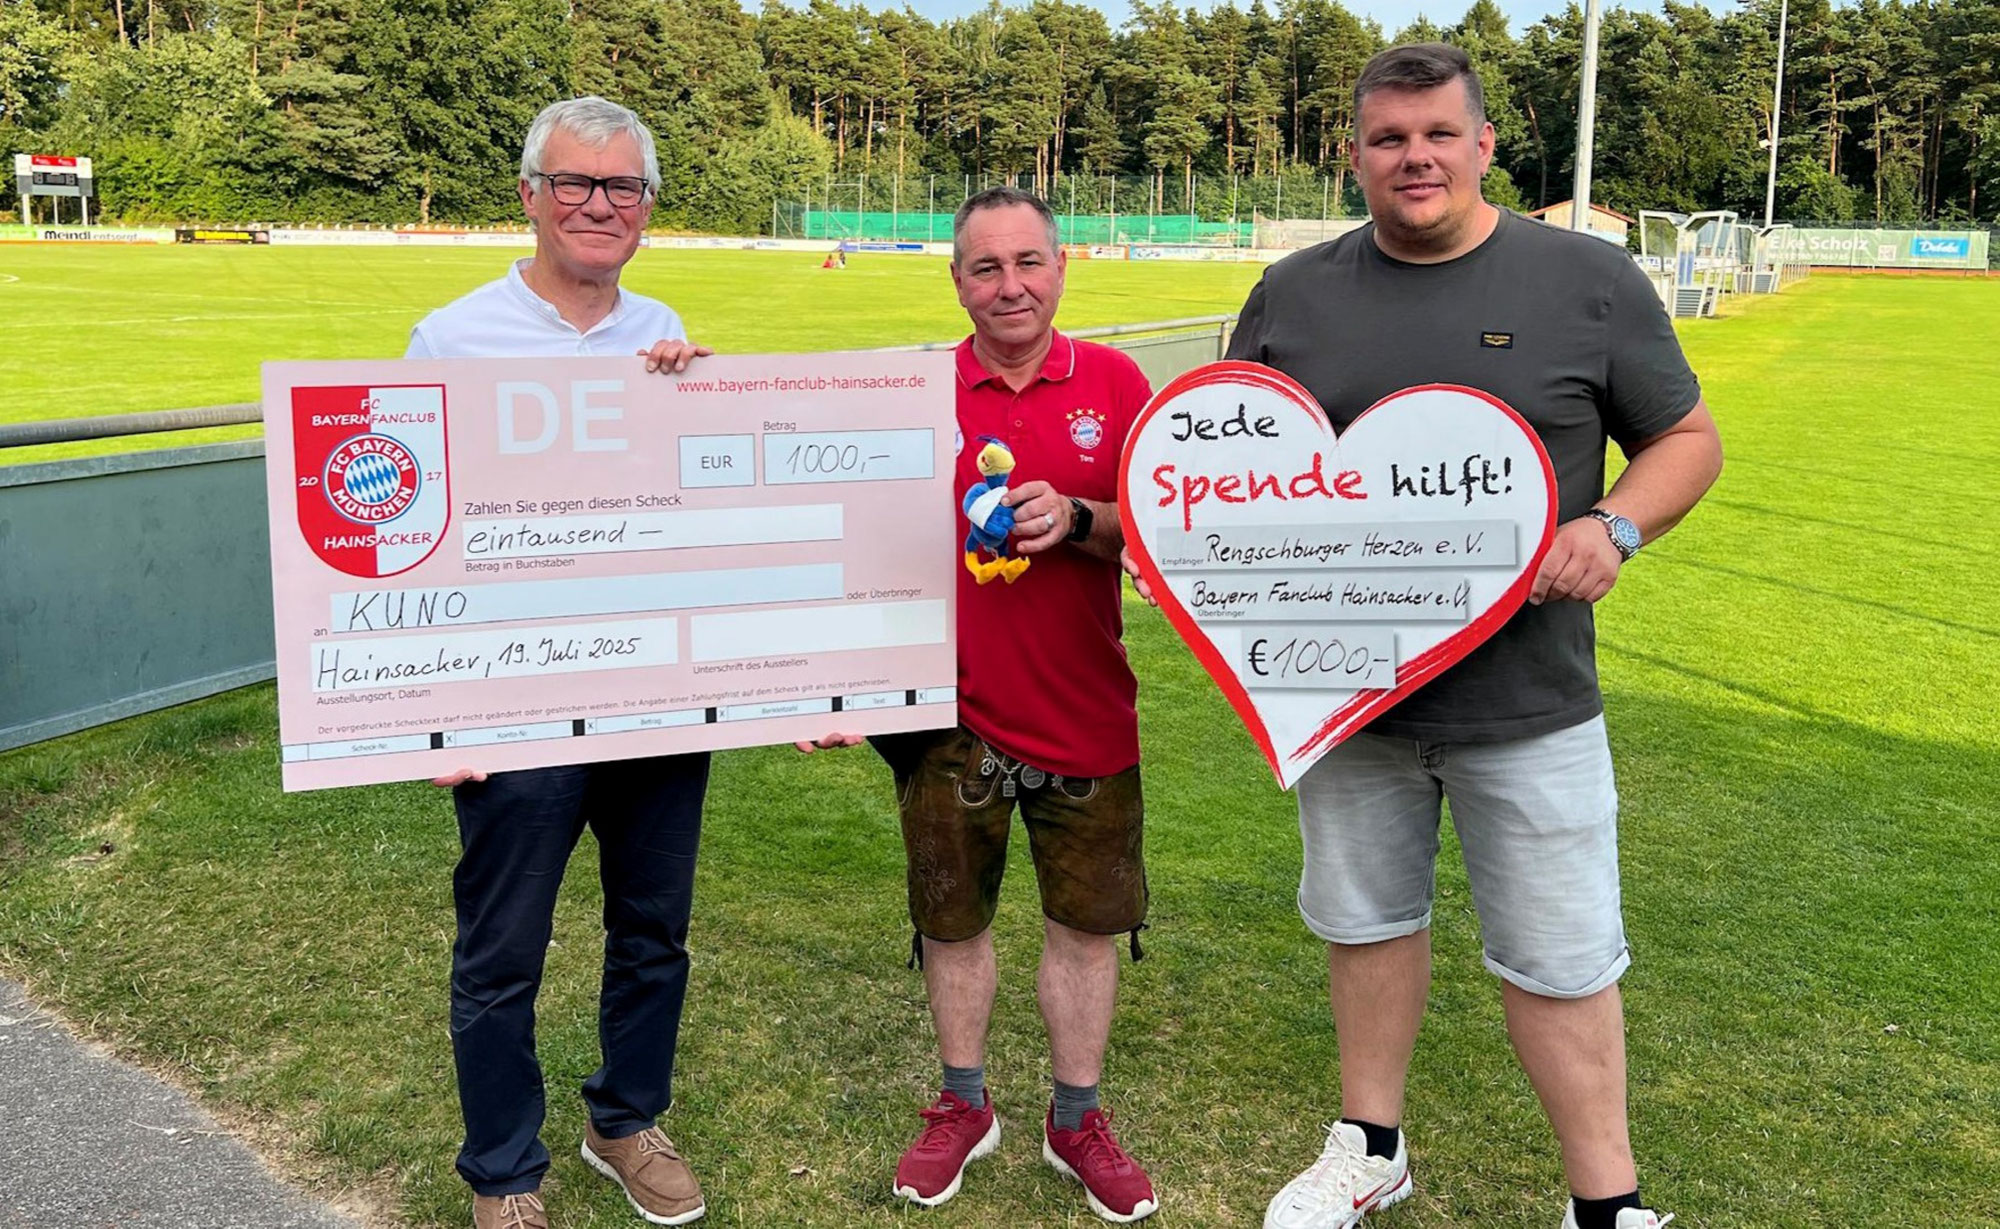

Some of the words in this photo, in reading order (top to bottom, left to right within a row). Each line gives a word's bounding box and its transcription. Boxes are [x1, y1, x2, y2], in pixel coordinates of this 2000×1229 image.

[676, 375, 926, 394] www.bayern-fanclub-hainsacker.de
[360, 398, 381, 411] FC
[496, 378, 630, 455] DE
[1169, 402, 1280, 442] Jede
[763, 421, 797, 432] Betrag
[330, 453, 350, 474] FC
[348, 440, 413, 472] BAYERN
[700, 455, 733, 469] EUR
[298, 476, 319, 487] 20
[426, 471, 443, 481] 17
[1152, 452, 1369, 532] Spende
[1389, 453, 1512, 507] hilft!
[332, 486, 414, 520] MÜNCHEN
[465, 501, 511, 516] Zahlen
[516, 499, 537, 513] Sie
[541, 498, 584, 514] gegen
[588, 496, 632, 509] diesen
[636, 494, 683, 508] Scheck
[323, 531, 433, 550] HAINSACKER
[466, 520, 628, 554] eintausend
[1205, 533, 1352, 565] Rengschburger
[1361, 531, 1423, 558] Herzen
[465, 562, 500, 573] Betrag
[503, 560, 513, 570] in
[516, 557, 576, 569] Buchstaben
[1162, 557, 1204, 566] Empfänger
[846, 589, 867, 600] oder
[869, 586, 923, 600] Überbringer
[1190, 580, 1259, 610] Bayern
[1267, 580, 1333, 603] Fanclub
[1340, 582, 1434, 607] Hainsacker
[348, 591, 467, 631] KUNO
[1197, 608, 1246, 618] Überbringer
[313, 628, 328, 637] an
[317, 648, 491, 690] Hainsacker,
[498, 641, 530, 665] 19.
[536, 638, 583, 667] Juli
[588, 636, 642, 659] 2025
[693, 662, 744, 675] Unterschrift
[748, 660, 761, 670] des
[763, 657, 809, 669] Ausstellers
[316, 690, 395, 706] Ausstellungsort,
[399, 688, 431, 700] Datum
[318, 726, 333, 735] Der
[336, 720, 392, 733] vorgedruckte
[395, 717, 440, 728] Schecktext
[443, 714, 460, 724] darf
[462, 713, 483, 722] nicht
[485, 709, 522, 721] geändert
[524, 708, 543, 717] oder
[545, 704, 587, 716] gestrichen
[623, 699, 636, 708] Die
[639, 697, 667, 708] Angabe
[669, 695, 689, 703] einer
[691, 689, 740, 702] Zahlungsfrist
[742, 688, 754, 698] auf
[756, 687, 773, 696] dem
[774, 685, 799, 695] Scheck
[802, 683, 814, 693] gilt
[816, 682, 826, 690] als
[828, 681, 846, 690] nicht
